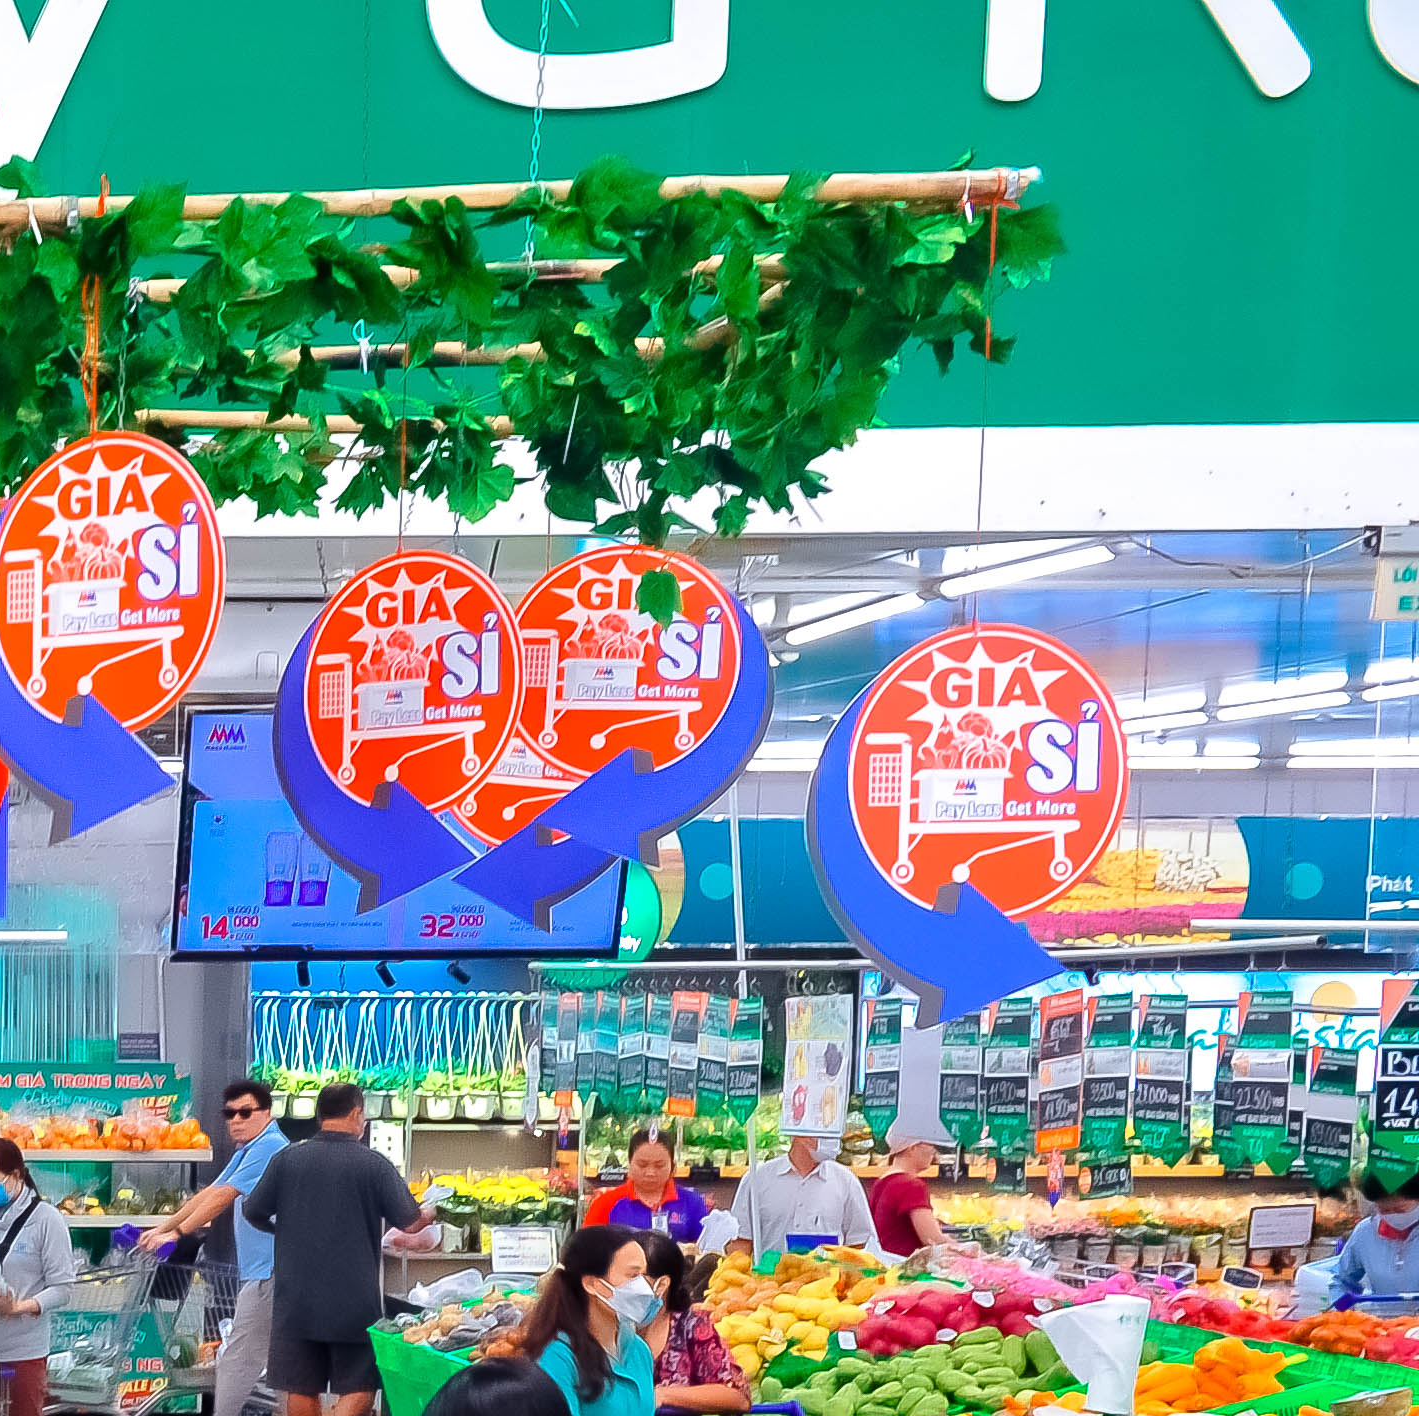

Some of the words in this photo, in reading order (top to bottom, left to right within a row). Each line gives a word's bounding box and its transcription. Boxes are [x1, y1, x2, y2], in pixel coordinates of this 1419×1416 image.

[576, 577, 643, 611] GI
[420, 915, 456, 939] 32
[52, 1073, 111, 1089] TRONG
